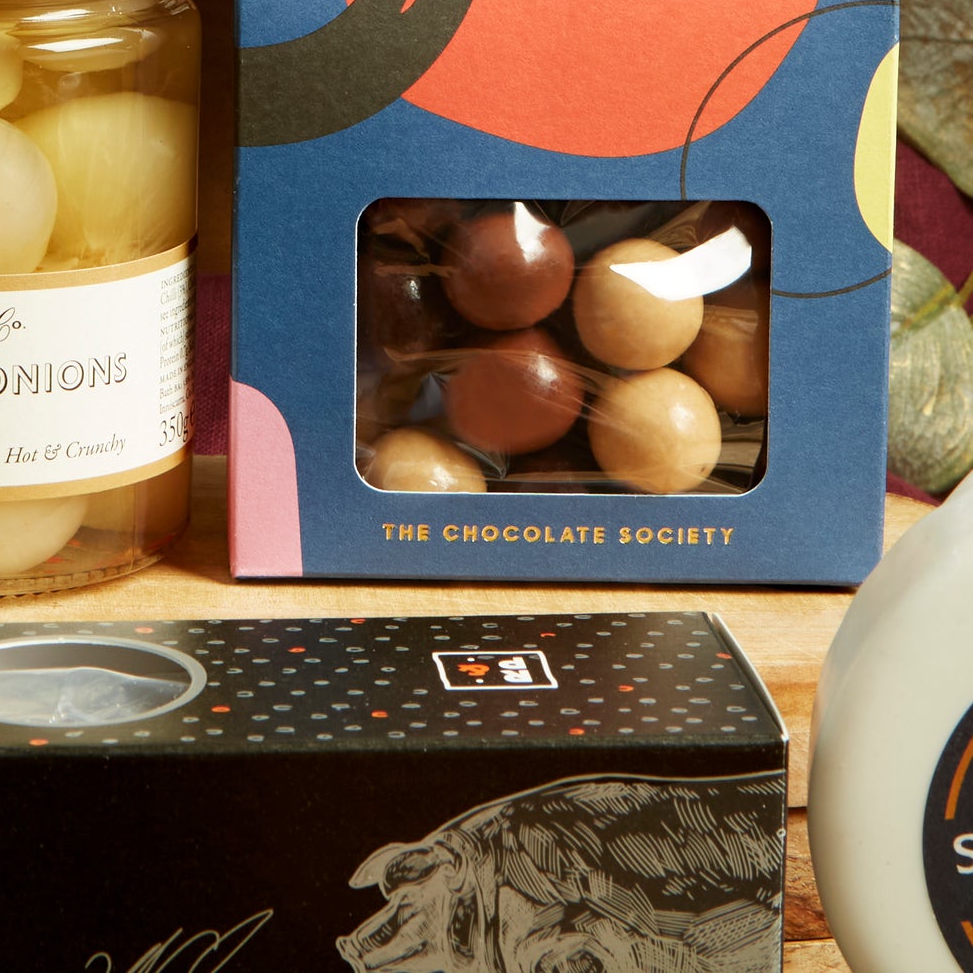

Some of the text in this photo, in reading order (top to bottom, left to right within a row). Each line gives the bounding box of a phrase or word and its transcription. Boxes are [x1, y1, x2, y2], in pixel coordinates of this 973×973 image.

[159, 411, 189, 447] 350g
[5, 447, 39, 464] Hot
[44, 444, 62, 461] &
[65, 433, 126, 458] Crunchy
[382, 524, 733, 544] THE CHOCOLATE SOCIETY
